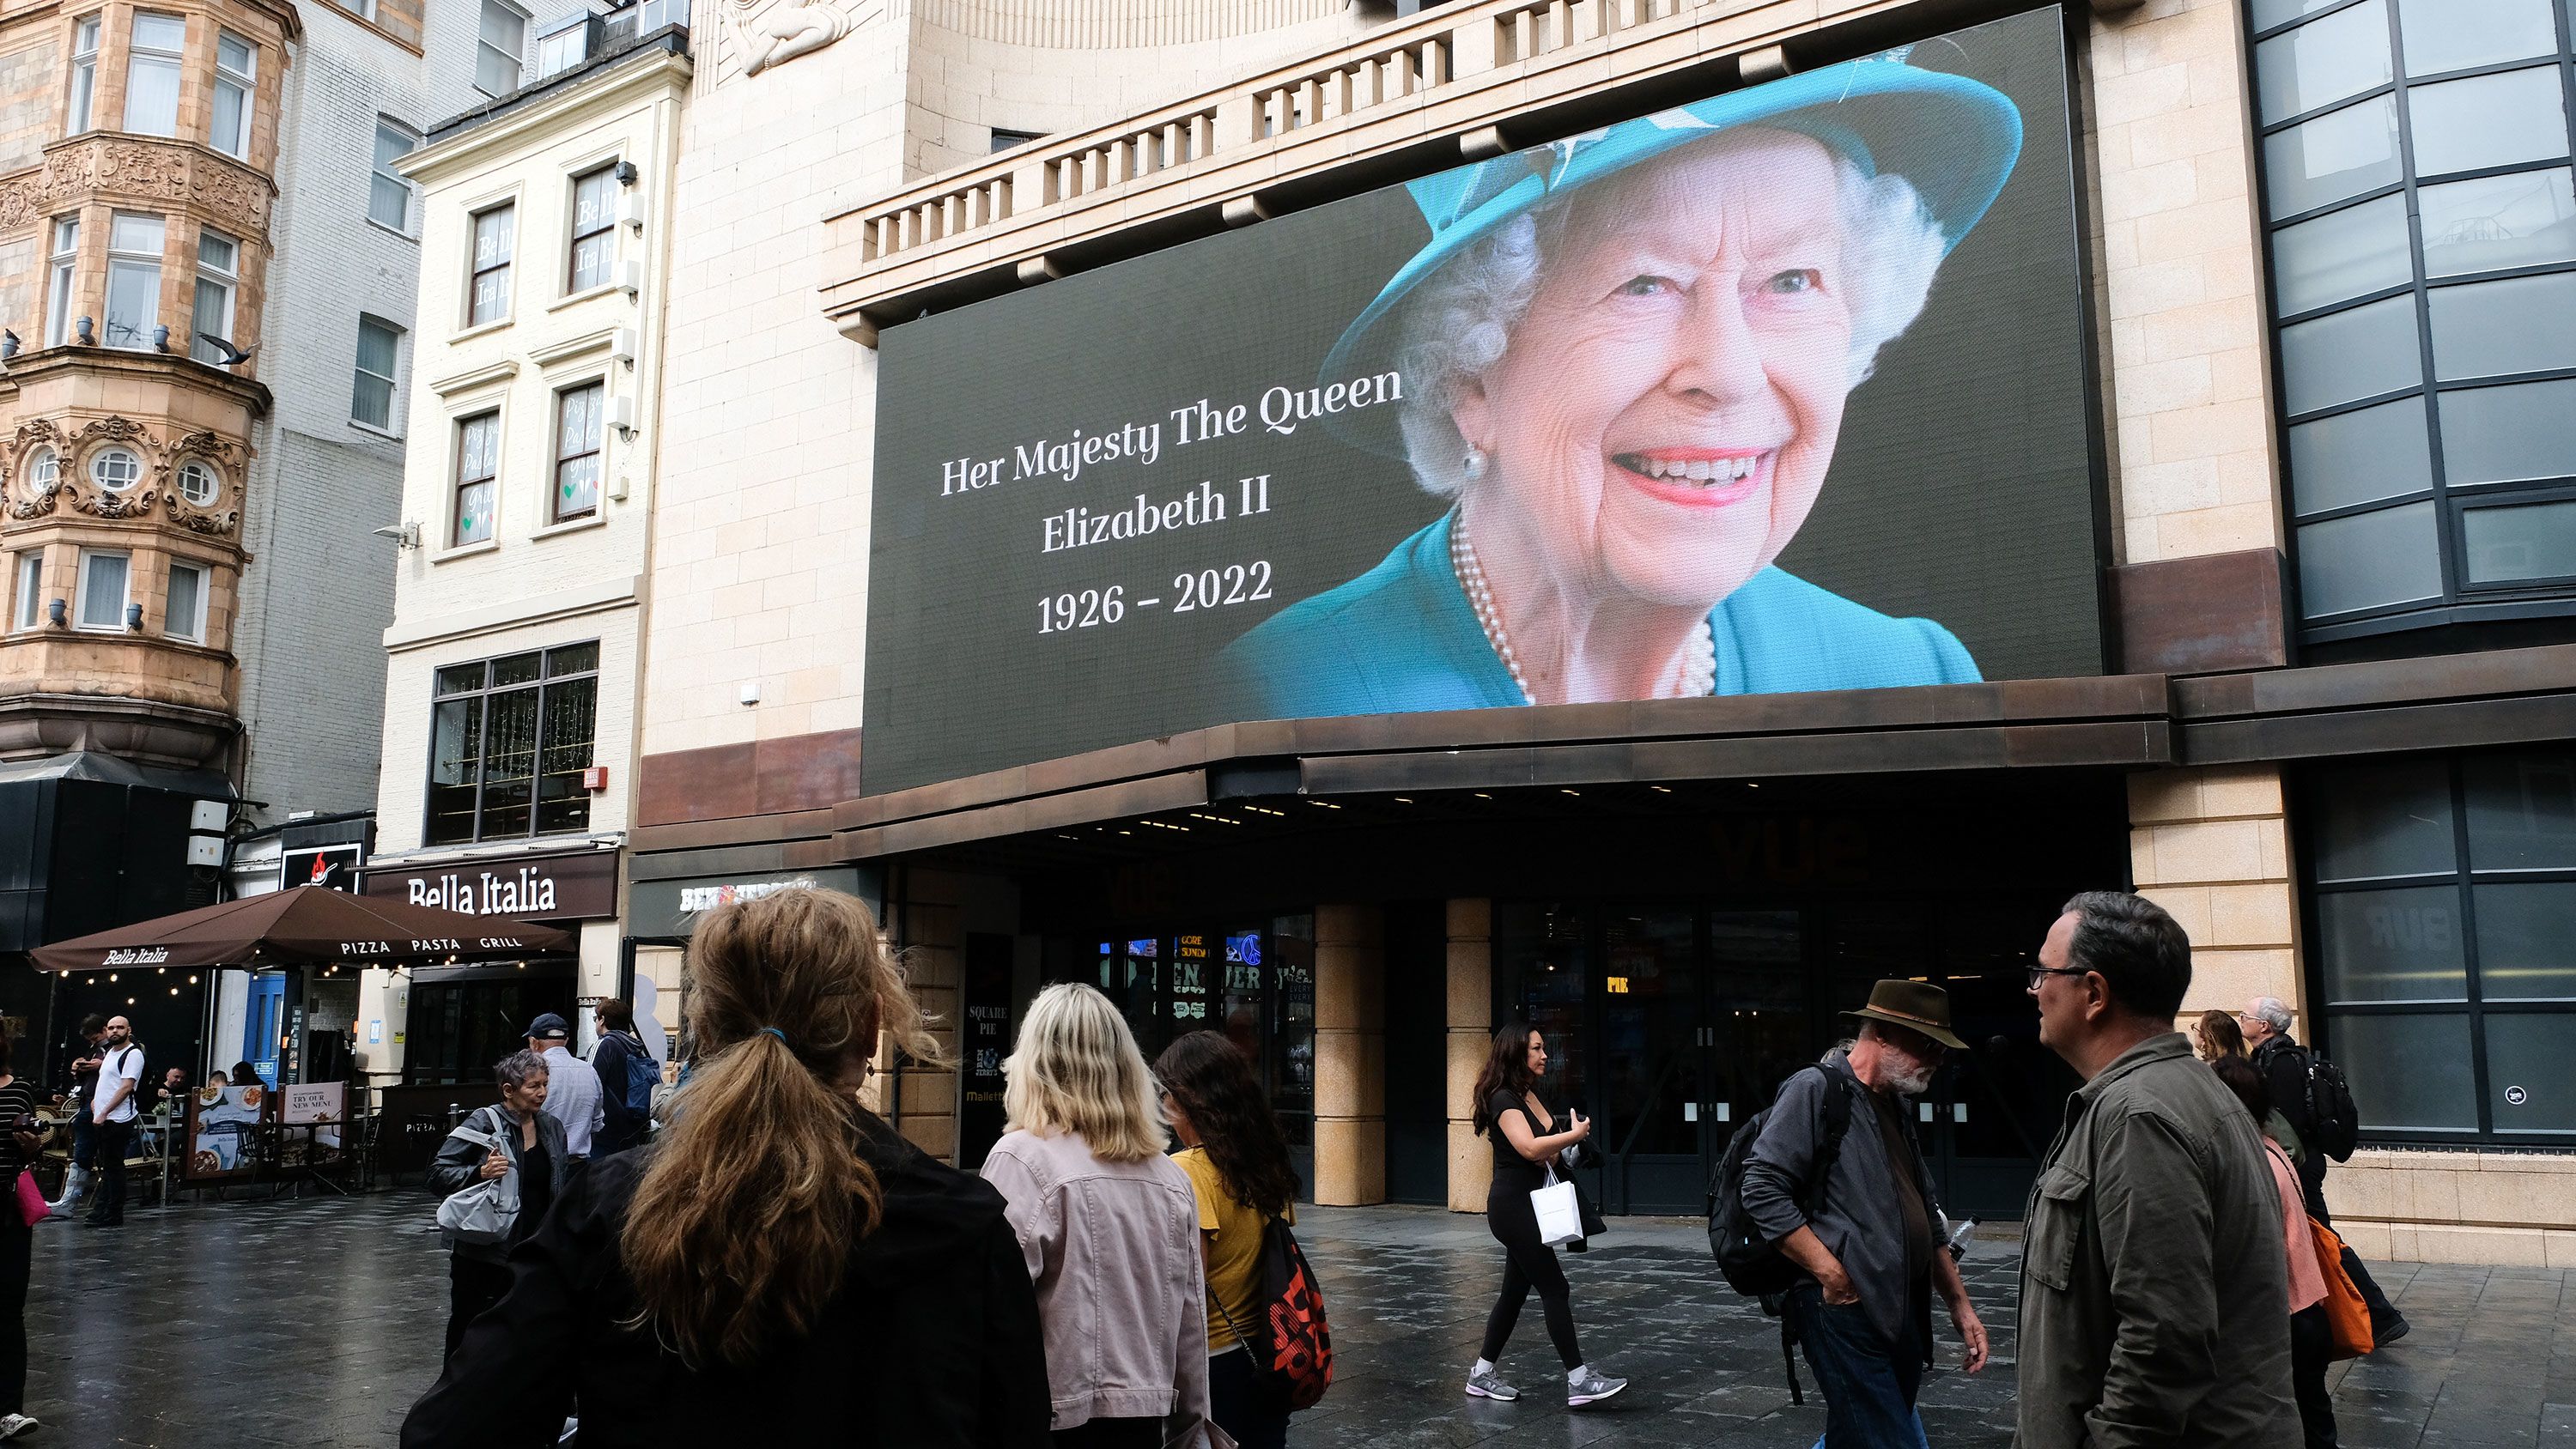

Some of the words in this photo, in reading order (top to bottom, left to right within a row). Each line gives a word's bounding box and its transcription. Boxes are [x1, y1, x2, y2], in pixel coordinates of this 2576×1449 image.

[477, 227, 513, 262] Bell
[576, 240, 612, 272] Itali
[564, 420, 601, 448] Pasta
[940, 456, 1006, 497] Her
[1012, 421, 1161, 482] Majesty
[1170, 397, 1248, 446] The
[1259, 370, 1404, 436] Queen
[464, 448, 496, 473] Pasta
[1041, 481, 1227, 554] Elizabeth
[1237, 474, 1272, 518] II
[1037, 585, 1125, 635] 1926
[1173, 561, 1273, 613] 2022
[408, 874, 475, 915] Bella
[480, 866, 556, 915] Italia
[102, 949, 136, 966] Bella
[133, 947, 169, 964] Italia
[341, 942, 391, 955] PIZZA
[411, 938, 461, 951] PASTA
[479, 937, 522, 949] GRILL
[969, 1005, 1008, 1021] SQUARE
[979, 1022, 997, 1035] PIE
[966, 1091, 1005, 1102] Mallett
